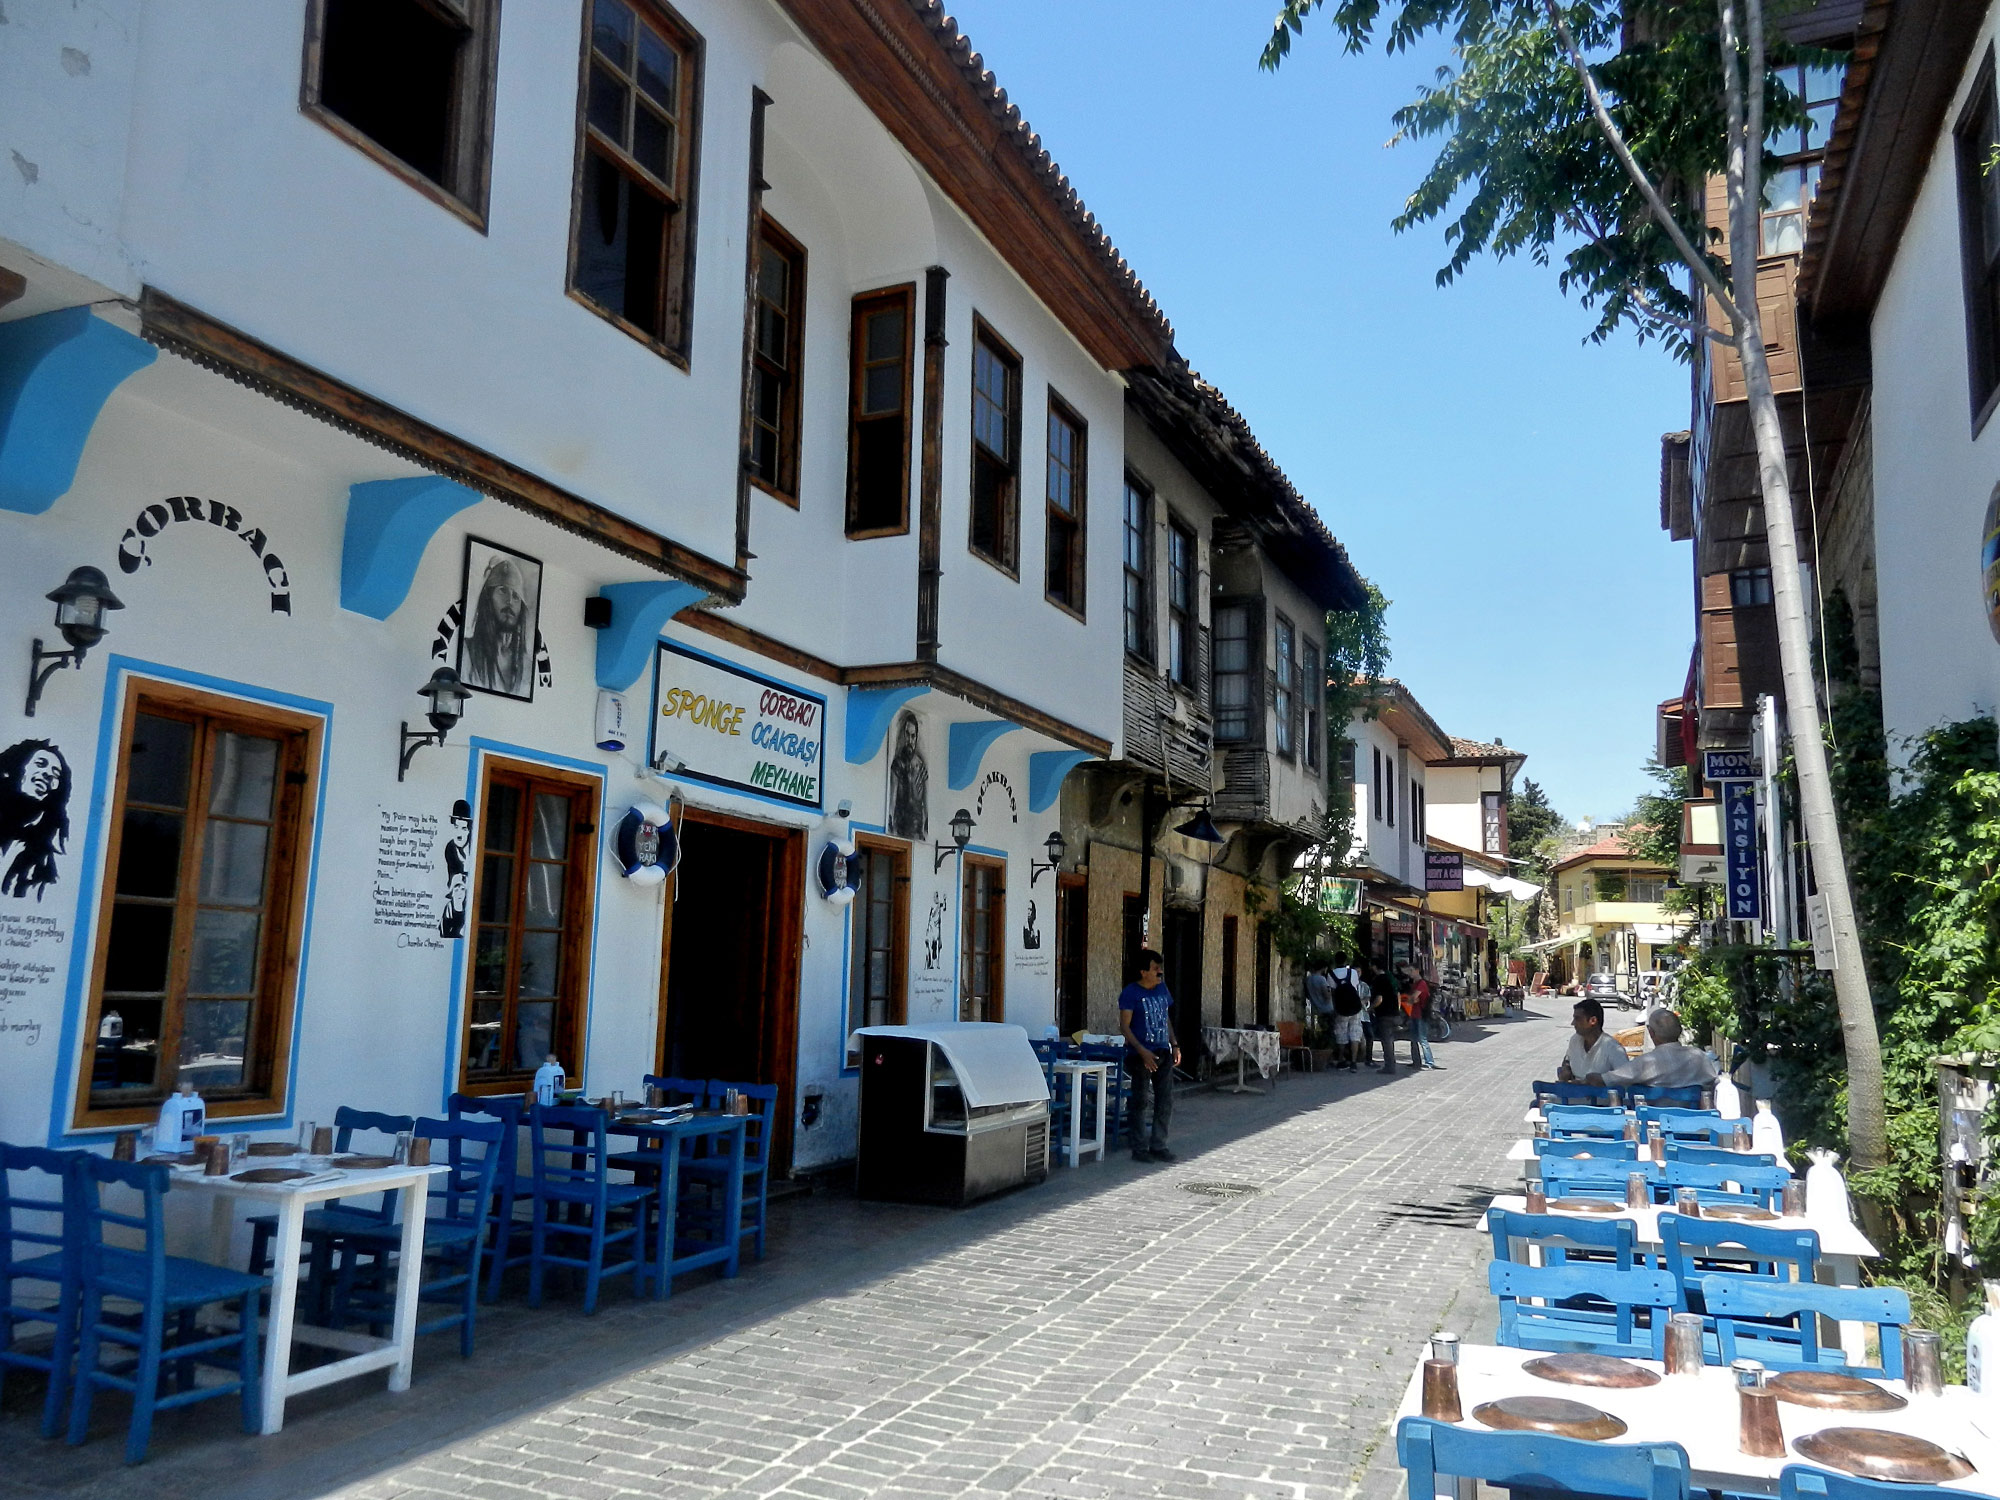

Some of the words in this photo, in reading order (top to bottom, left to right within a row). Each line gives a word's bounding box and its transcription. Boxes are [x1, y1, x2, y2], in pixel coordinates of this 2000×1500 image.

[118, 496, 292, 617] ÇORBACI
[662, 687, 746, 736] SPONGE
[760, 689, 816, 728] ÇORBACI
[751, 721, 819, 767] OCAKBAŞI
[750, 760, 817, 799] MEYHANE
[1732, 786, 1752, 914] PANSİYON
